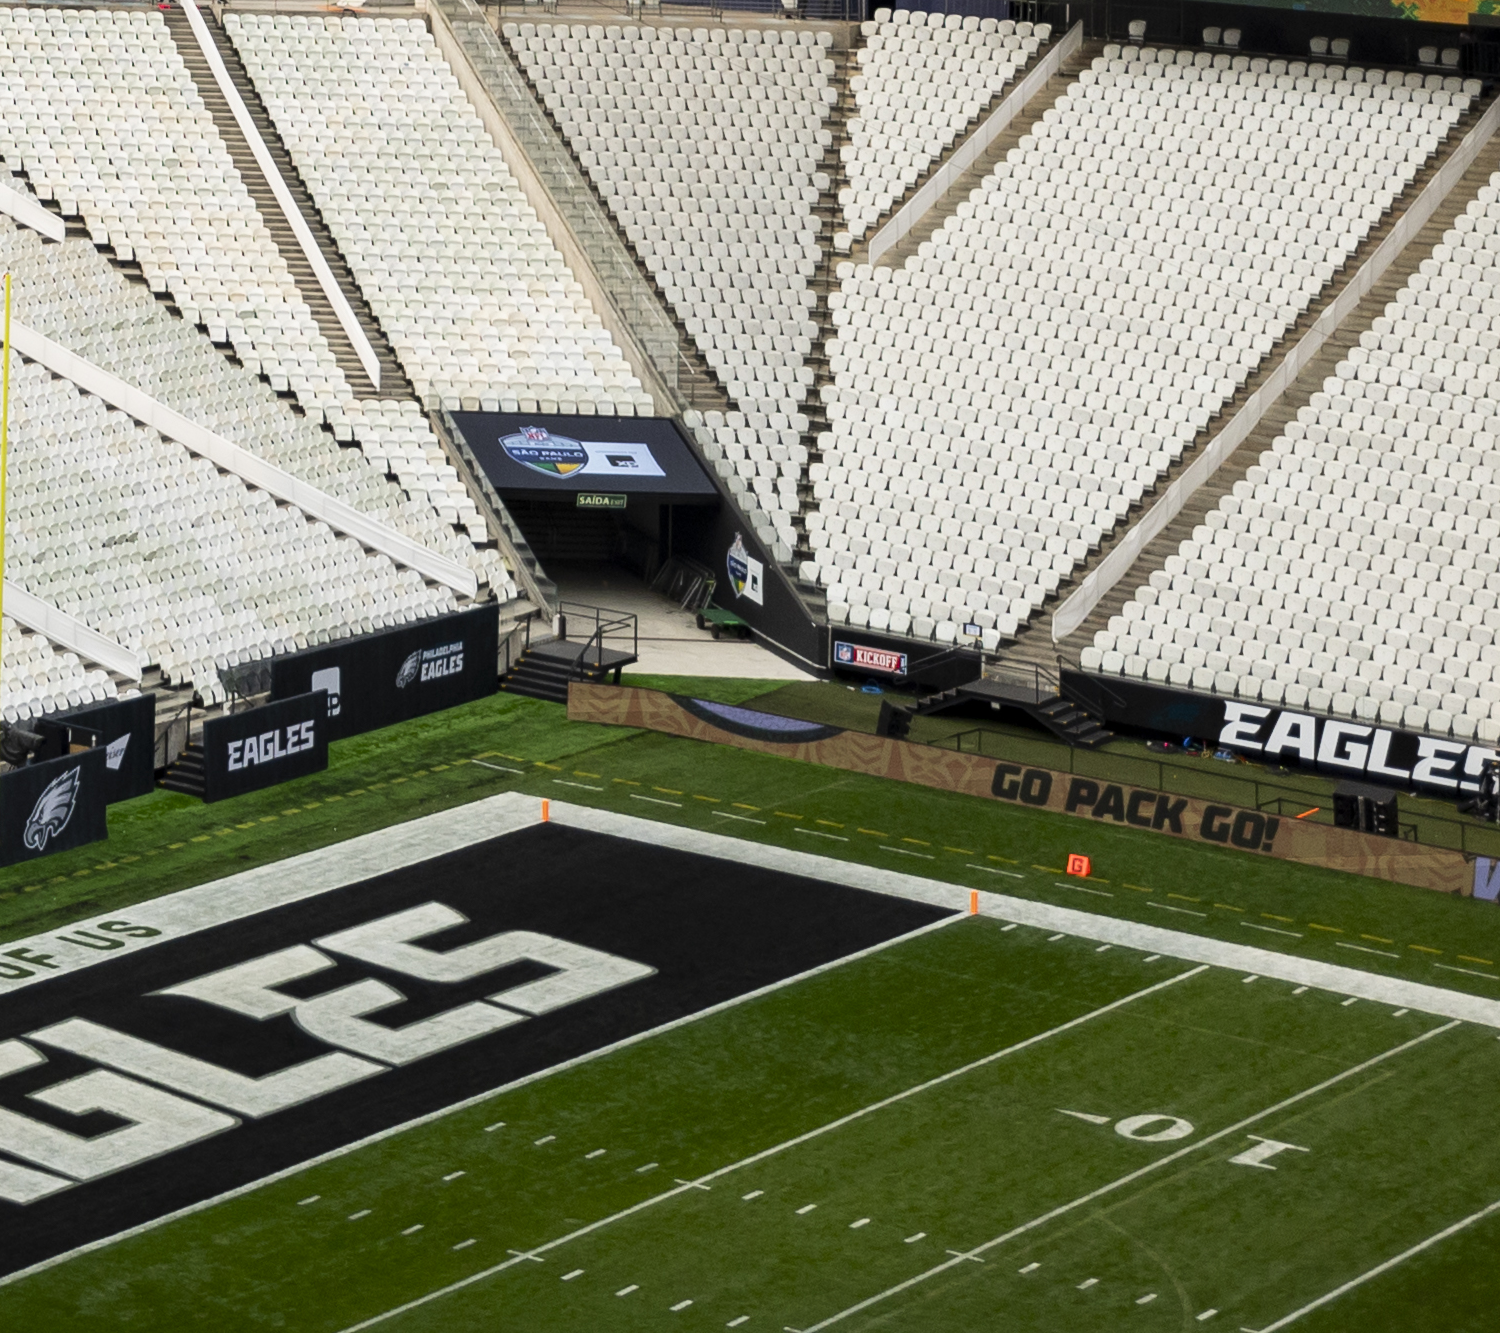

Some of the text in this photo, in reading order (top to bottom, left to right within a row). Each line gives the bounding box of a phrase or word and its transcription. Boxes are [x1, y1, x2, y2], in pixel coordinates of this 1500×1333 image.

[511, 447, 539, 457] SÃO
[541, 449, 584, 458] PAULO
[579, 494, 610, 506] SAÍDA
[420, 652, 464, 682] EAGLES
[855, 650, 899, 669] KICKOFF
[227, 719, 315, 772] EAGLES
[1217, 699, 1500, 795] EAGLES
[990, 762, 1280, 854] GO PACK GO!
[1071, 857, 1084, 873] G
[56, 920, 162, 951] US
